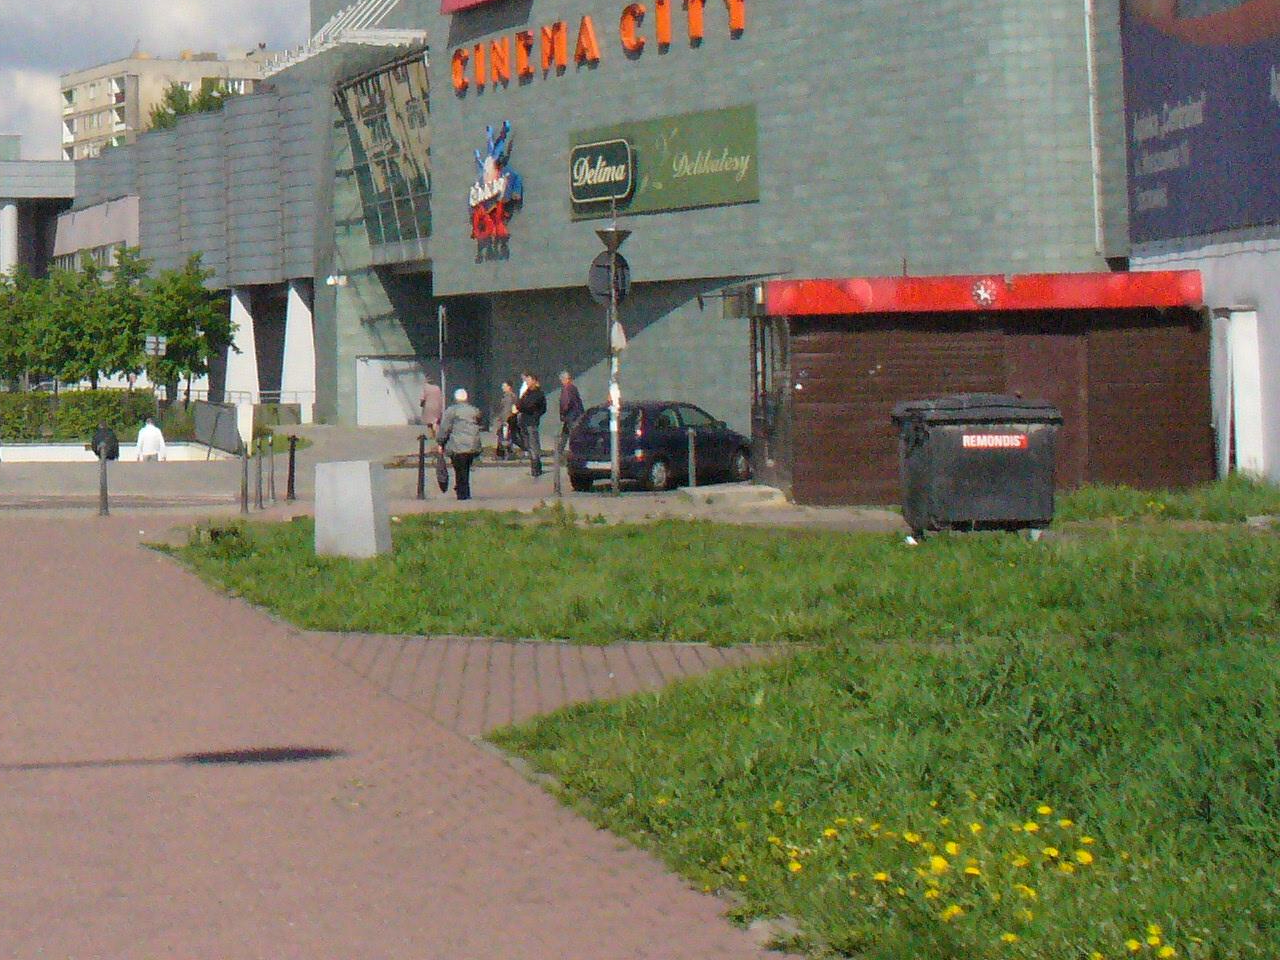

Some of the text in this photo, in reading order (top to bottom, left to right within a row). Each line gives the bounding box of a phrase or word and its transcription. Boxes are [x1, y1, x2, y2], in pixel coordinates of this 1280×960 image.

[451, 15, 601, 93] CINEMA
[572, 155, 628, 187] Delima
[672, 148, 752, 182] Delikatesy
[962, 434, 1021, 448] REMONDIS
